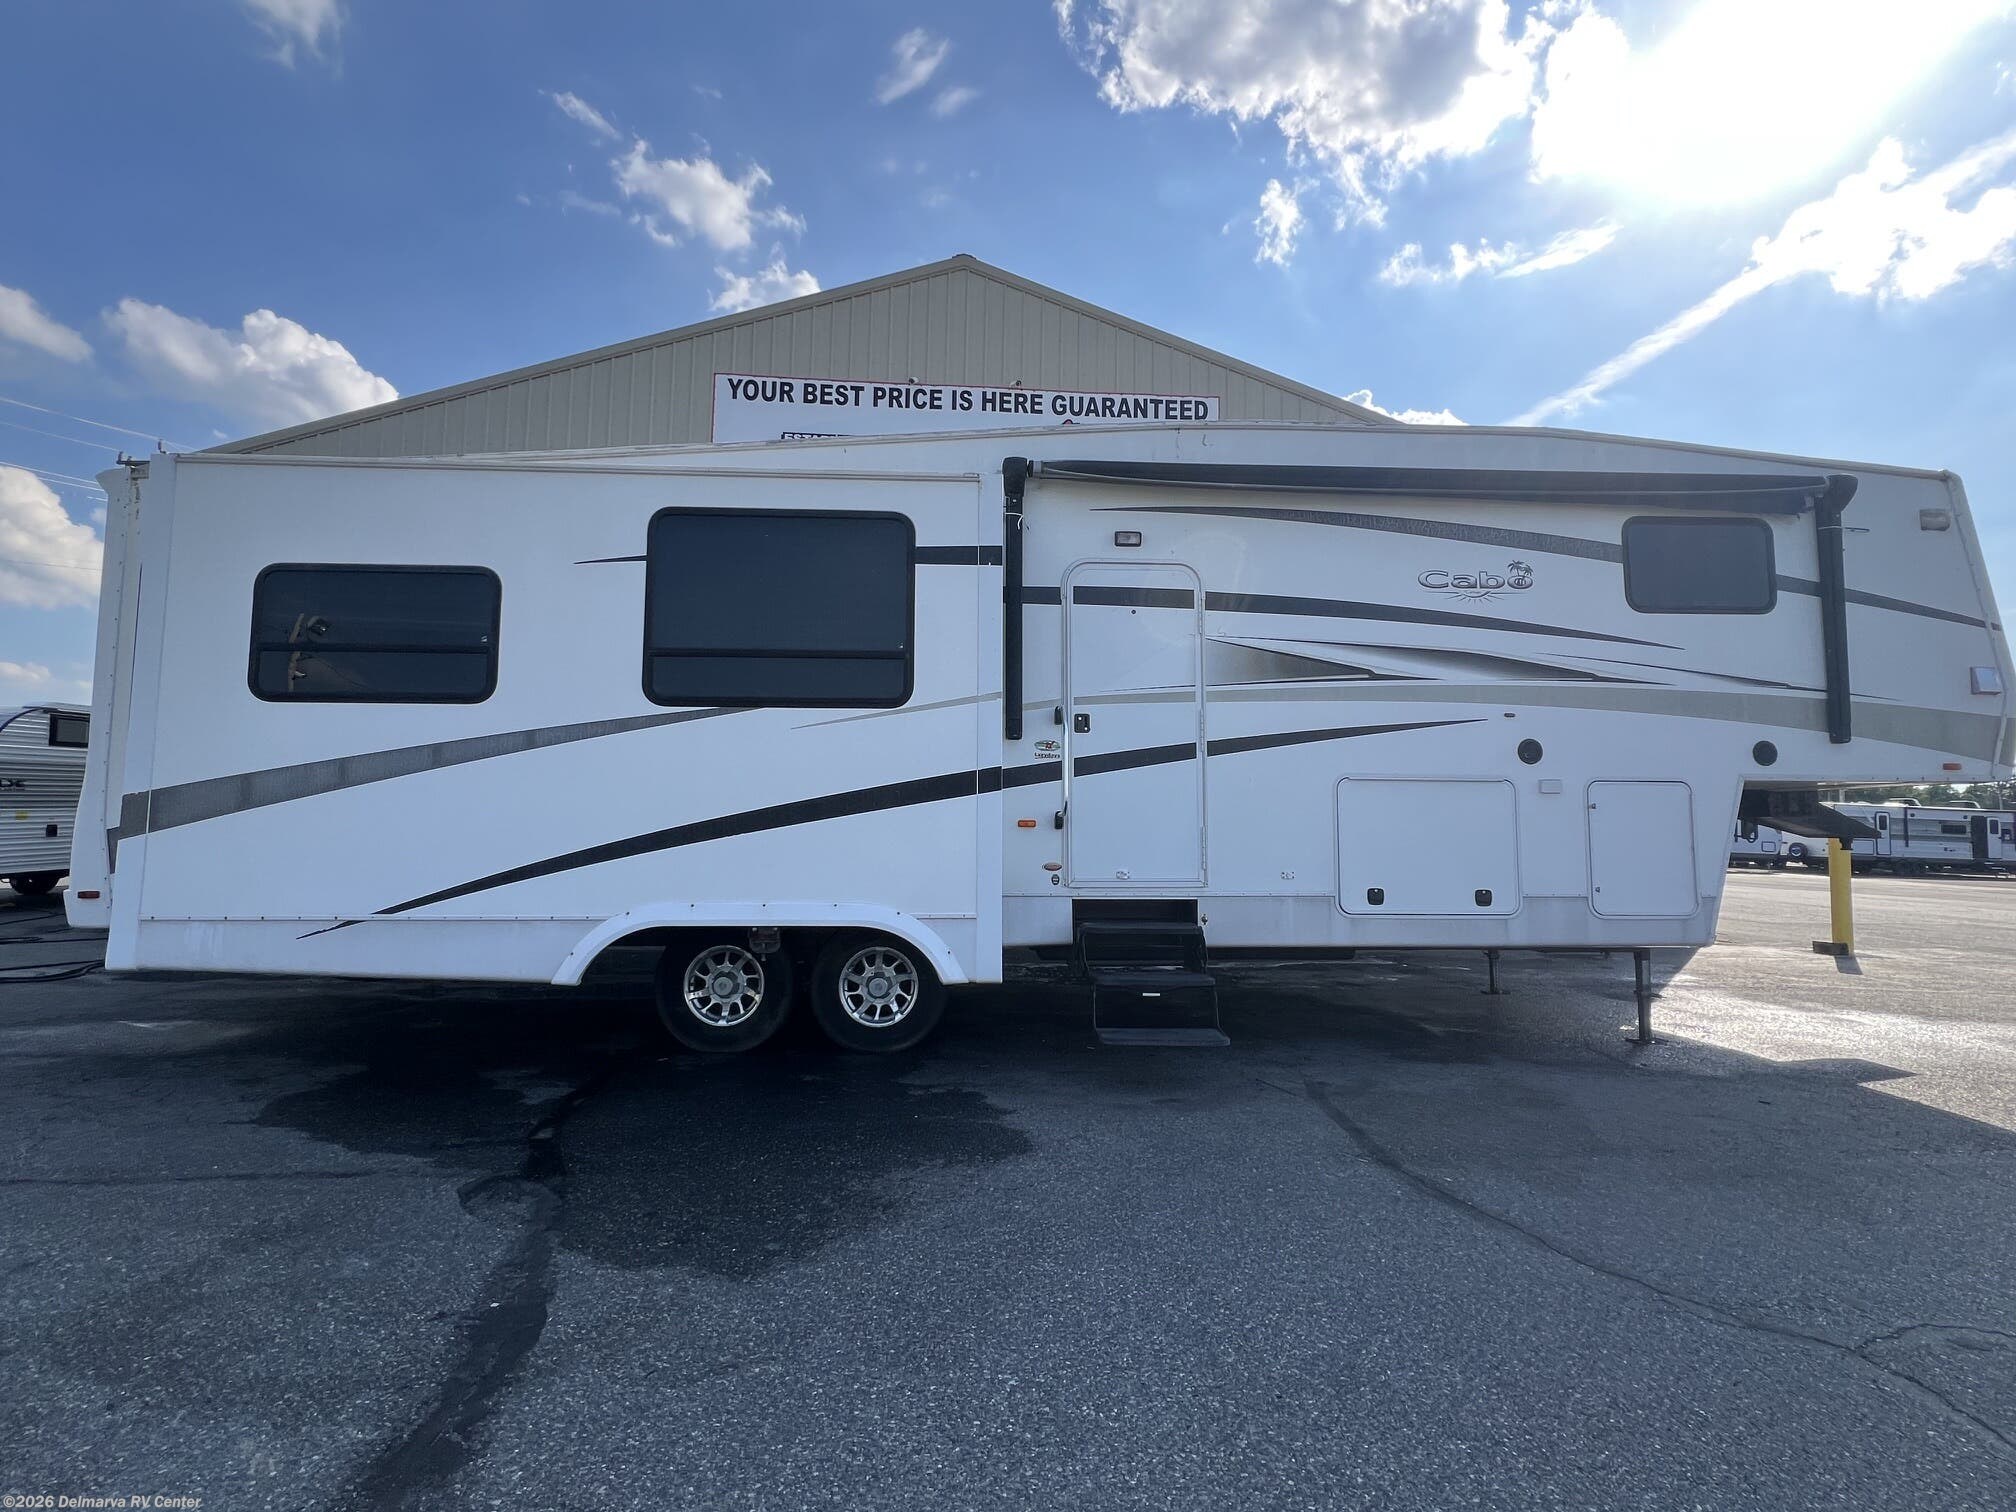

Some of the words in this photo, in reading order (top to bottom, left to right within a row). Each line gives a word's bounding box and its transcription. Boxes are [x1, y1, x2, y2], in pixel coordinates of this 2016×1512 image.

[728, 378, 794, 403] YOUR
[803, 383, 864, 407] BEST
[873, 387, 942, 410] PRICE
[952, 390, 974, 411] IS
[982, 391, 1043, 414] HERE
[1051, 394, 1208, 420] GUARANTEED
[1418, 569, 1533, 589] Cabo
